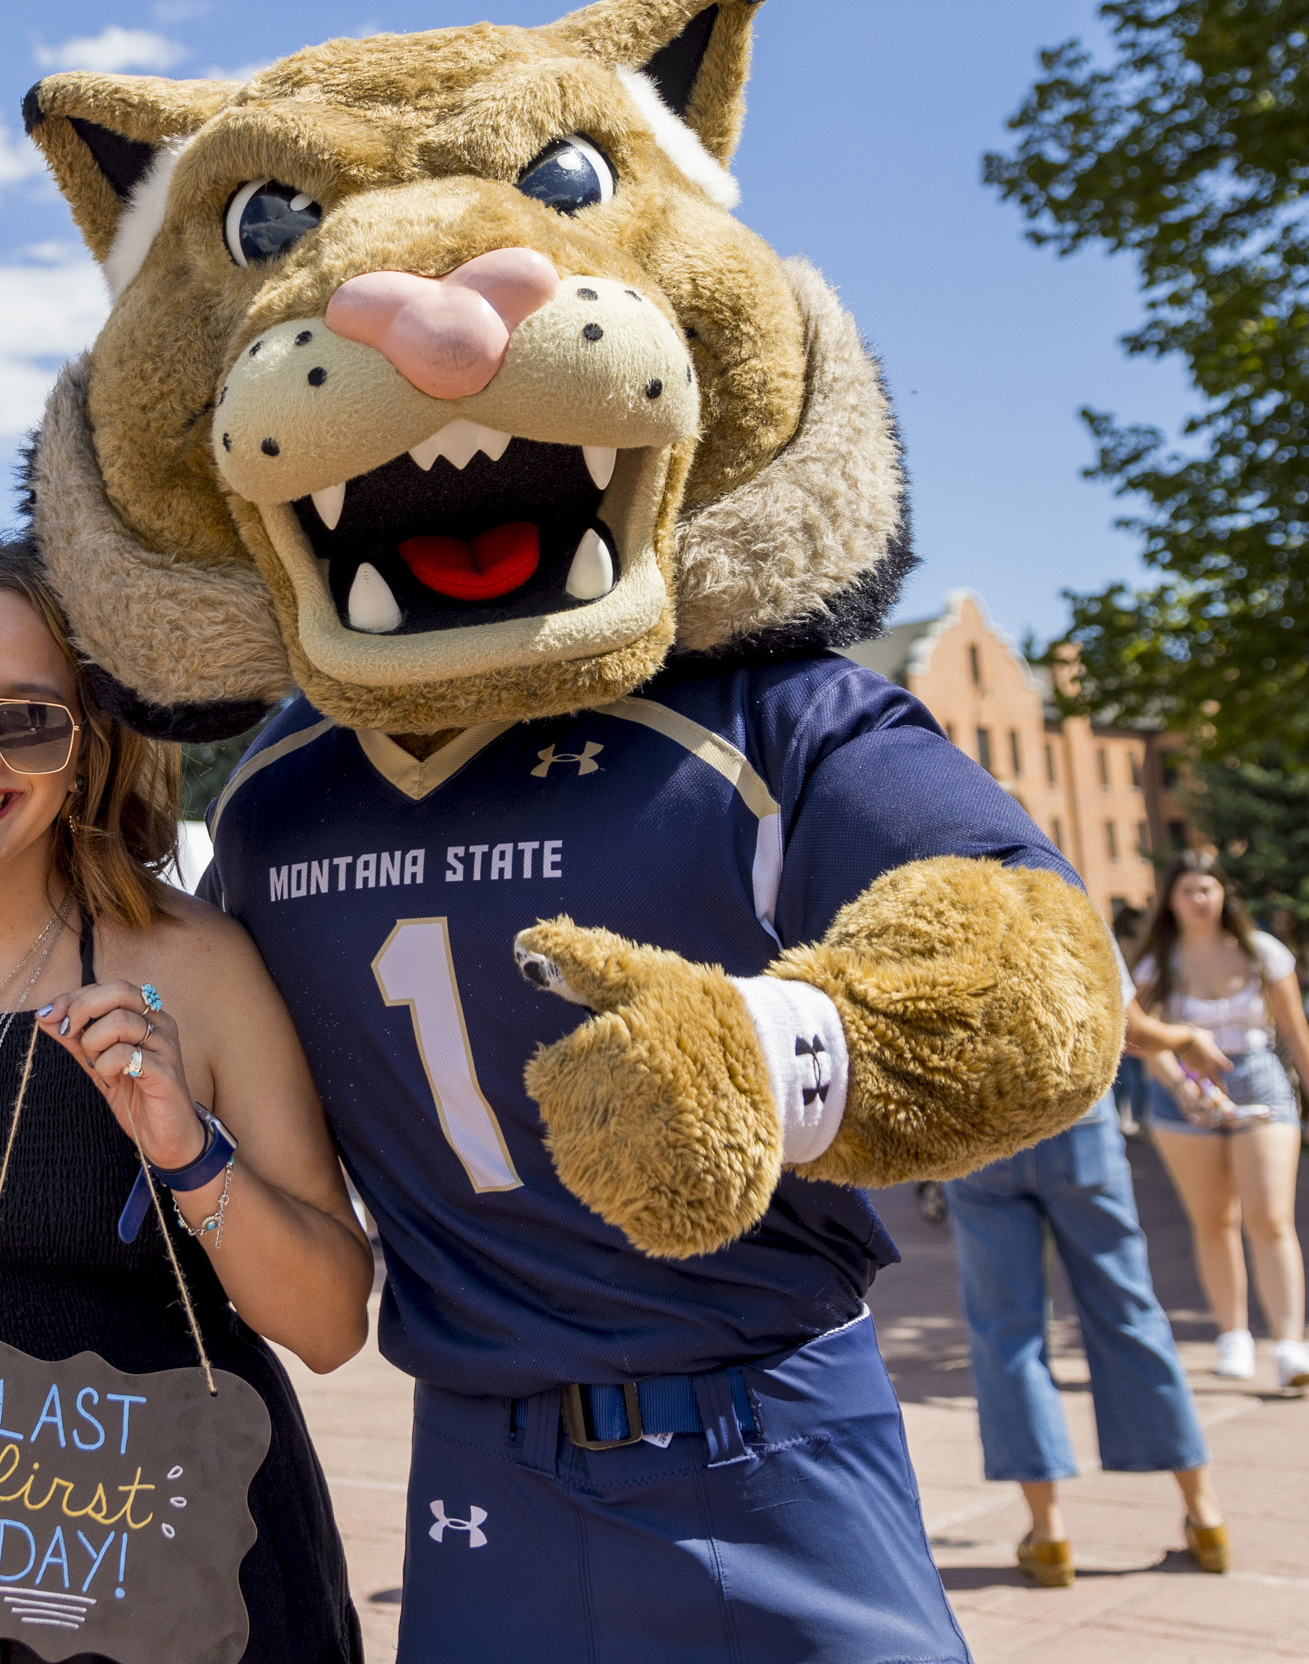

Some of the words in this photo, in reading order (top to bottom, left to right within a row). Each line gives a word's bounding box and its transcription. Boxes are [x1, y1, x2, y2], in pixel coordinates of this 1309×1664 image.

[269, 848, 426, 902] MONTANA
[445, 840, 564, 882] STATE
[370, 916, 525, 1194] 1
